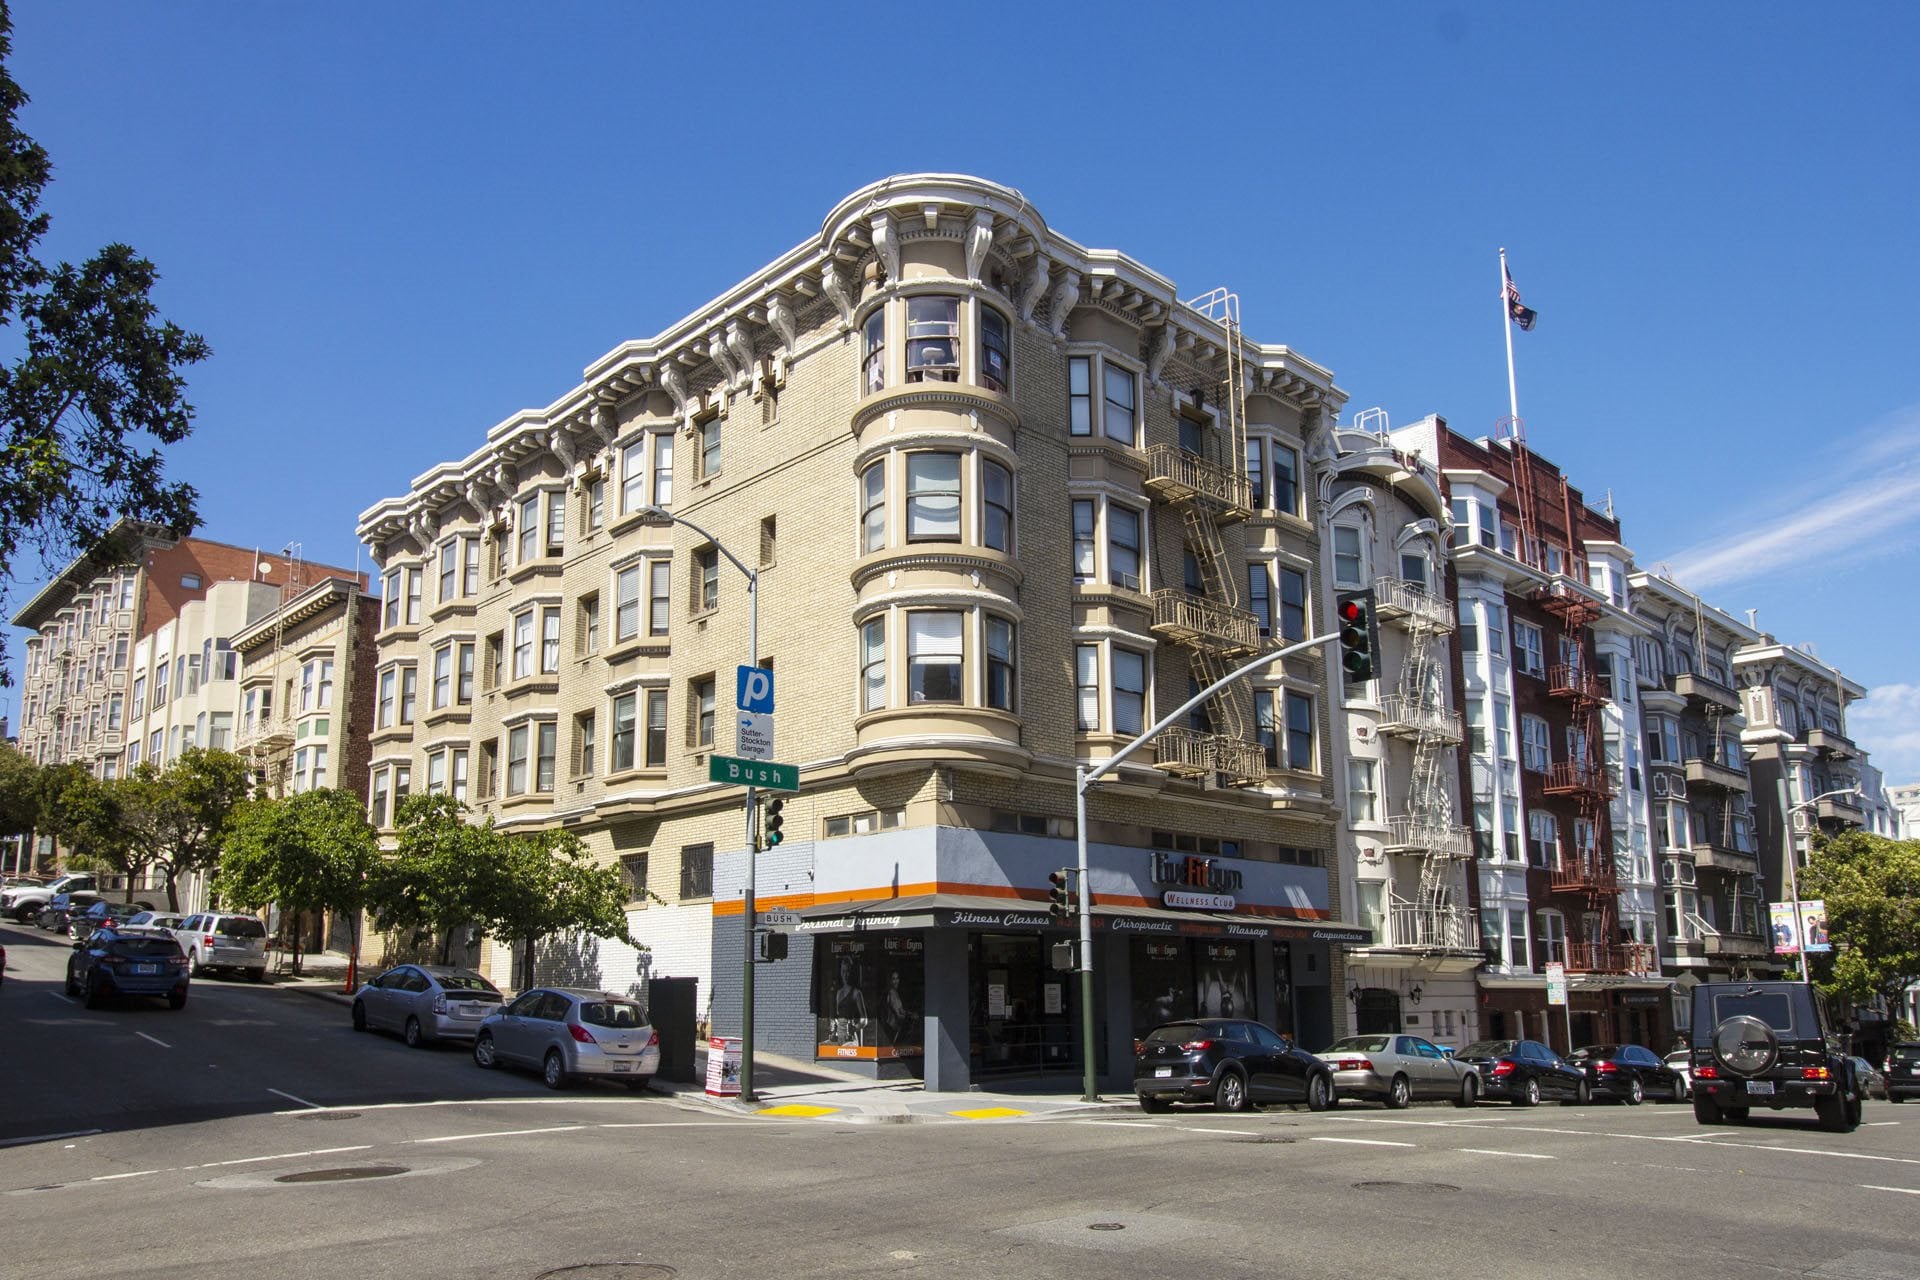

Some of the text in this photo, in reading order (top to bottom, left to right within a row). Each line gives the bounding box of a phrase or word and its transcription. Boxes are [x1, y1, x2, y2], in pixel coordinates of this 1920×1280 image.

[741, 728, 764, 738] Sutter-
[741, 736, 771, 747] Stockton
[740, 744, 765, 755] Garage
[729, 763, 781, 784] Bush
[766, 914, 792, 923] BUSH
[795, 914, 901, 932] Personal Training
[950, 911, 1000, 924] Fitness
[1003, 913, 1050, 926] Classes
[1112, 918, 1173, 931] Chiropractic
[1227, 925, 1269, 937] Massage
[1312, 930, 1363, 941] Acupuncture
[837, 1048, 858, 1057] FITNESS
[891, 1048, 914, 1057] CARDIO
